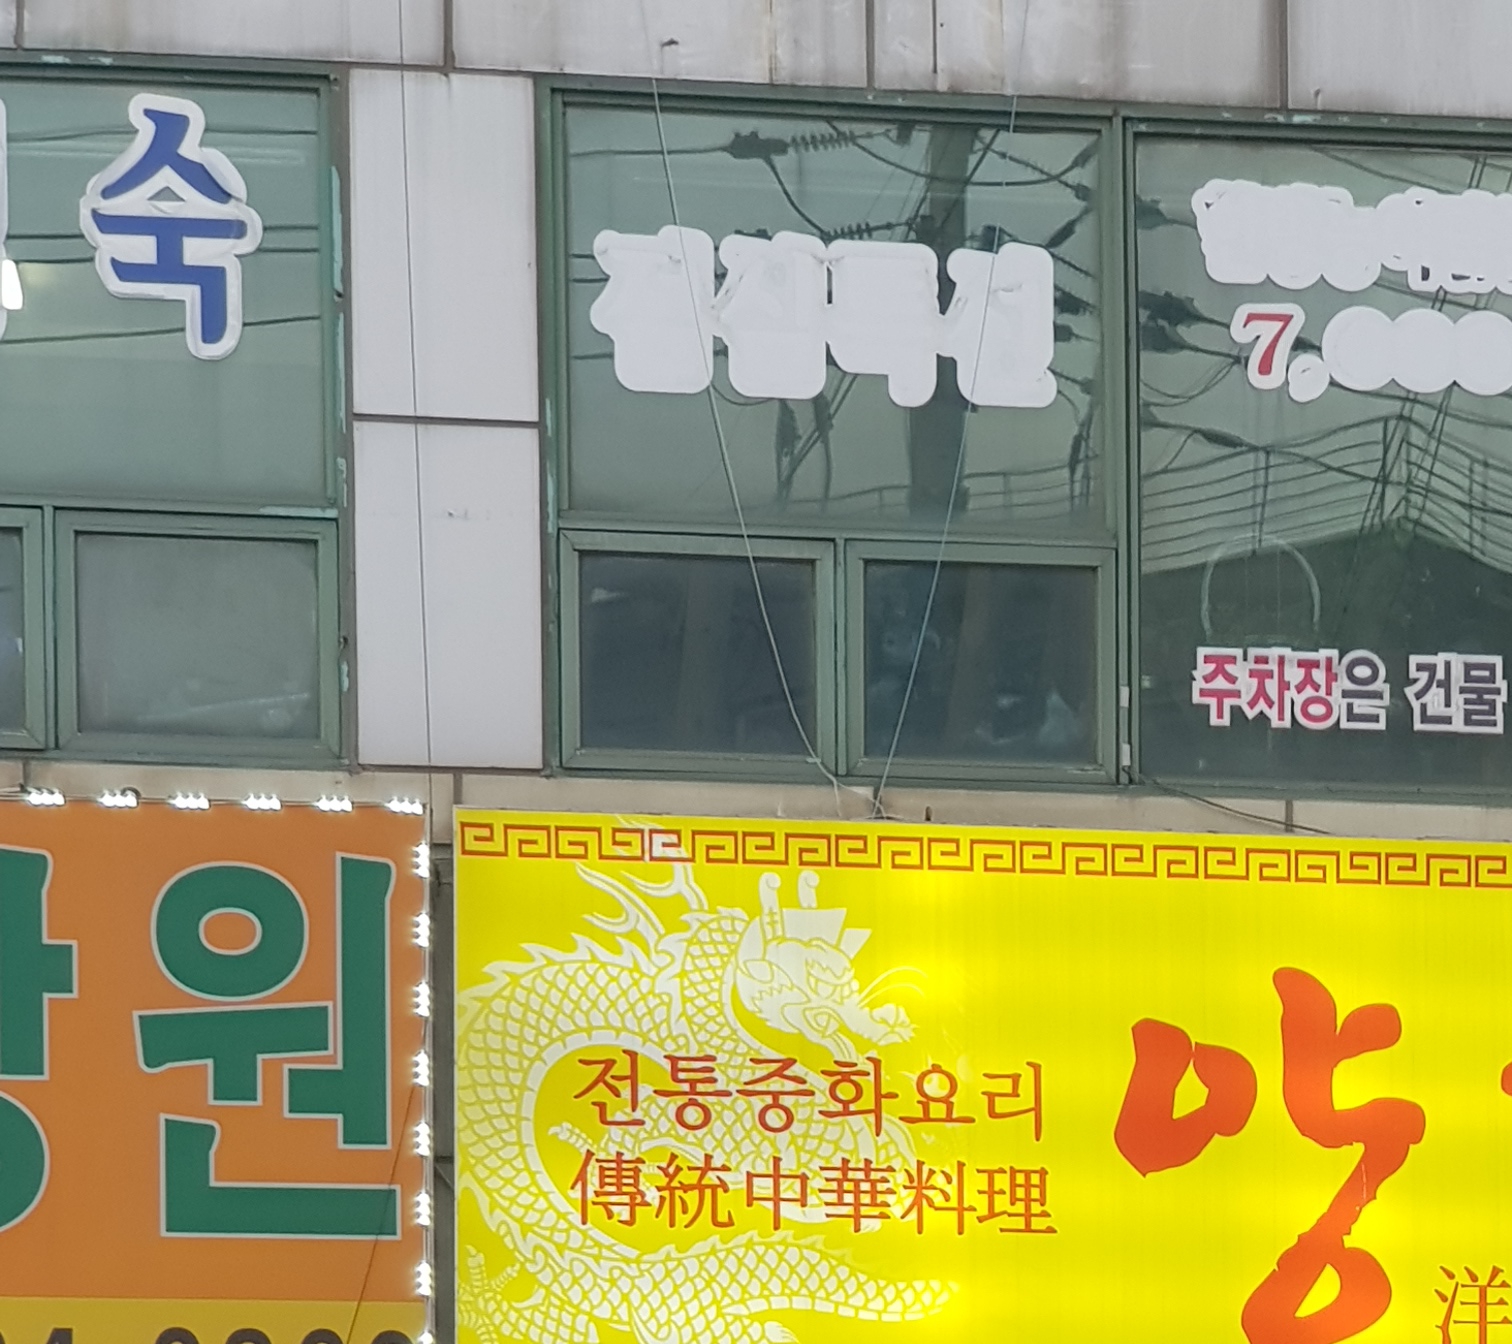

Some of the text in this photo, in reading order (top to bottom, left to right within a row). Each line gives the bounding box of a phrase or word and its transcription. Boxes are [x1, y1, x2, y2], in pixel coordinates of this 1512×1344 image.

[1199, 653, 1385, 726] 주차장은
[1414, 659, 1504, 730] 건물
[573, 1049, 1046, 1141] 전통중화요리
[569, 1150, 1059, 1236] 傳統中華料理
